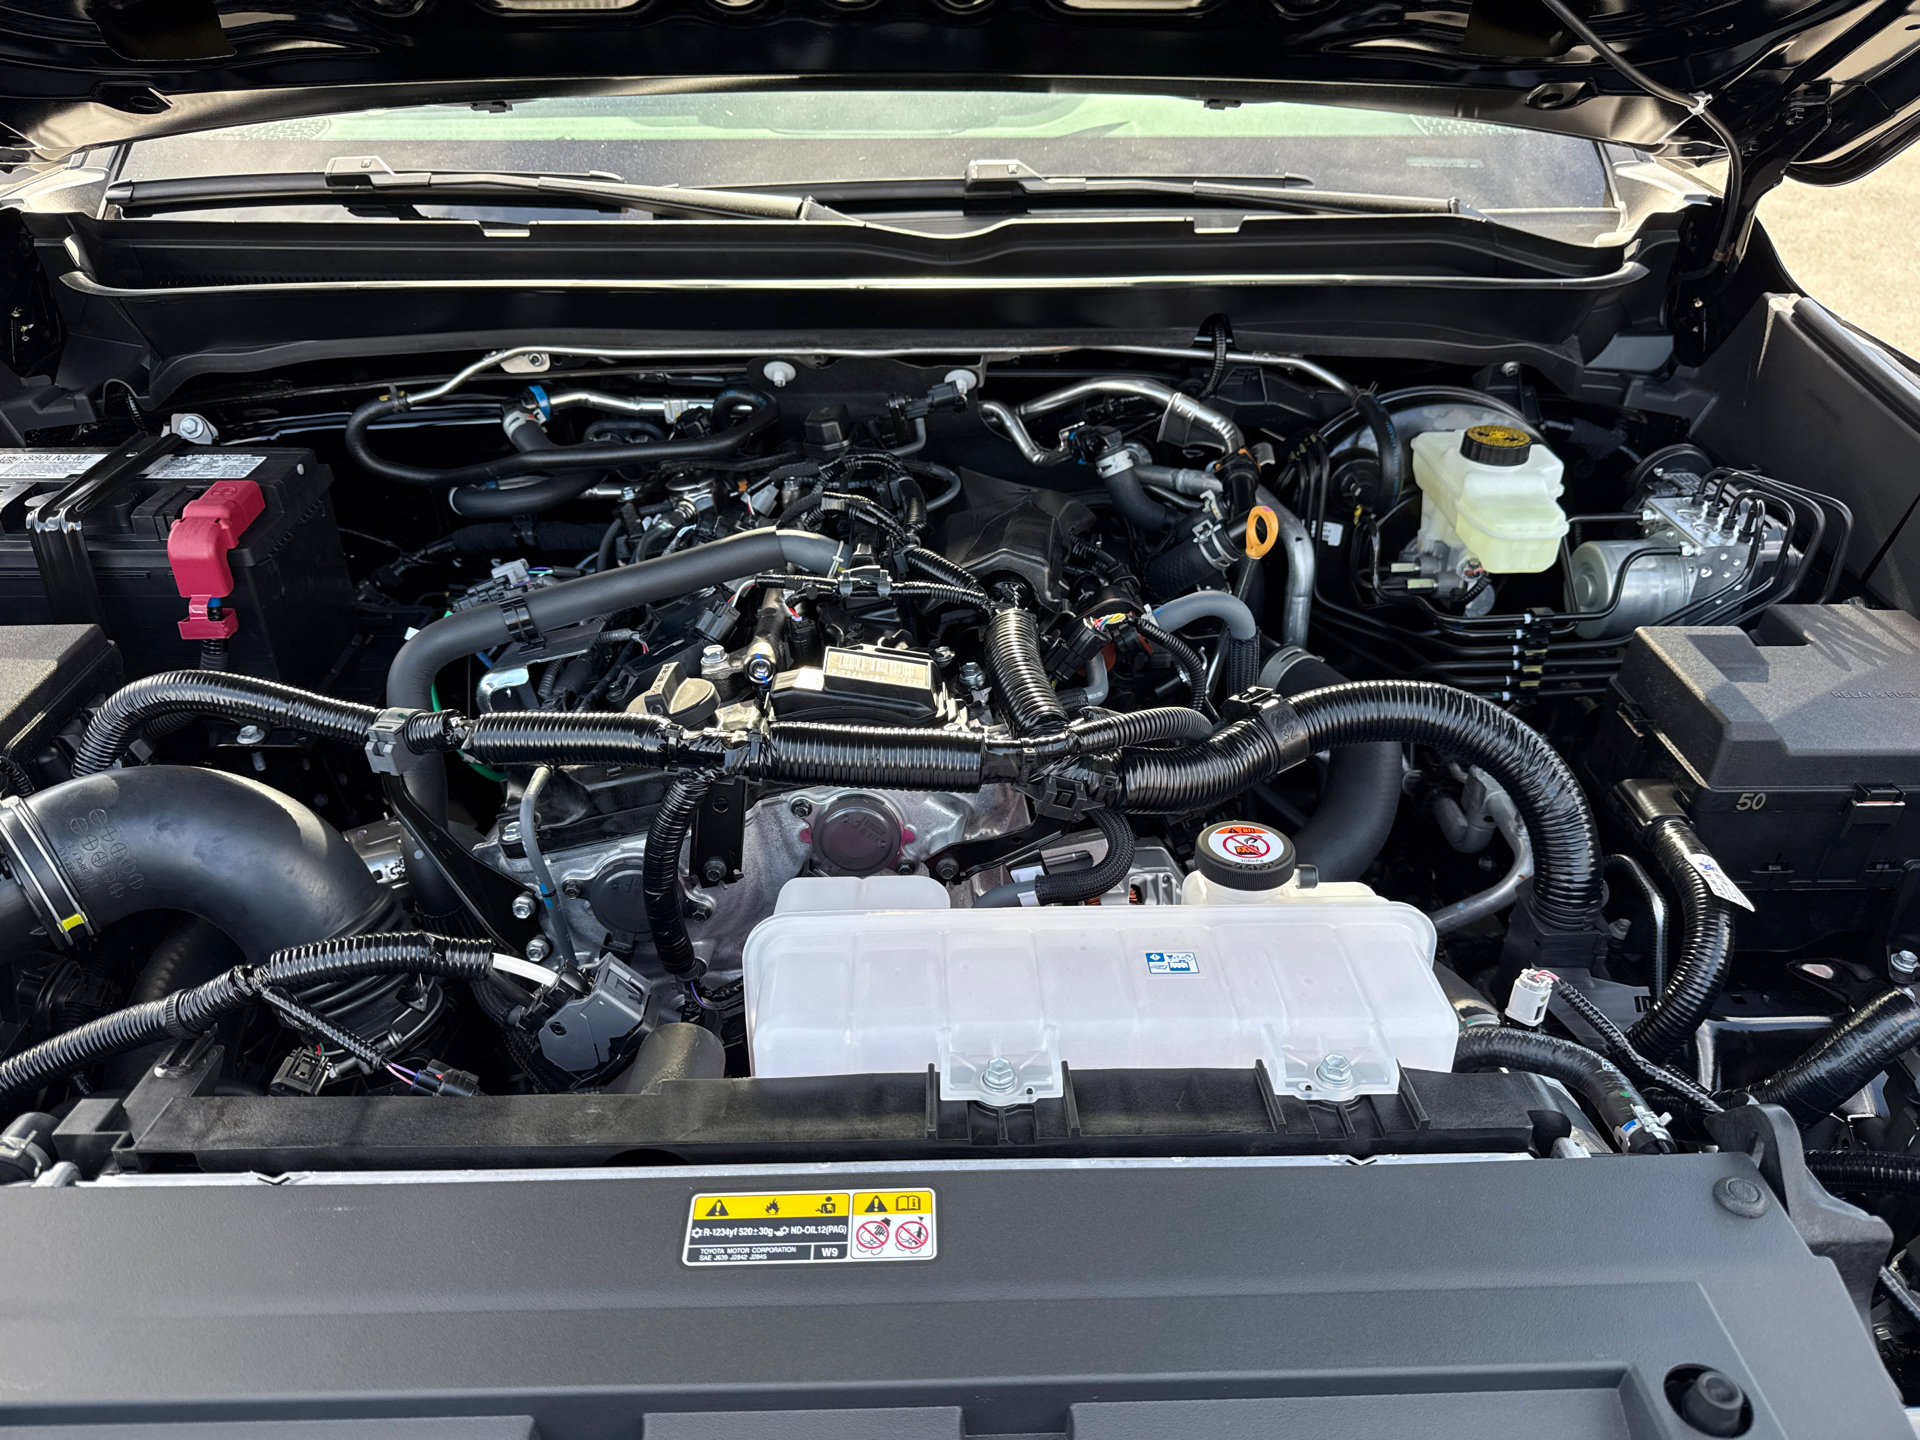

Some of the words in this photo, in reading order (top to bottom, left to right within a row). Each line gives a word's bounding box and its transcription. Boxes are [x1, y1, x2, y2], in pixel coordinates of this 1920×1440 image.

[1736, 793, 1767, 810] 50
[703, 1227, 738, 1238] R-1234yf
[738, 1226, 774, 1237] 520±30g
[790, 1225, 847, 1235] ND-OIL12(PAG)
[821, 1247, 839, 1257] W9
